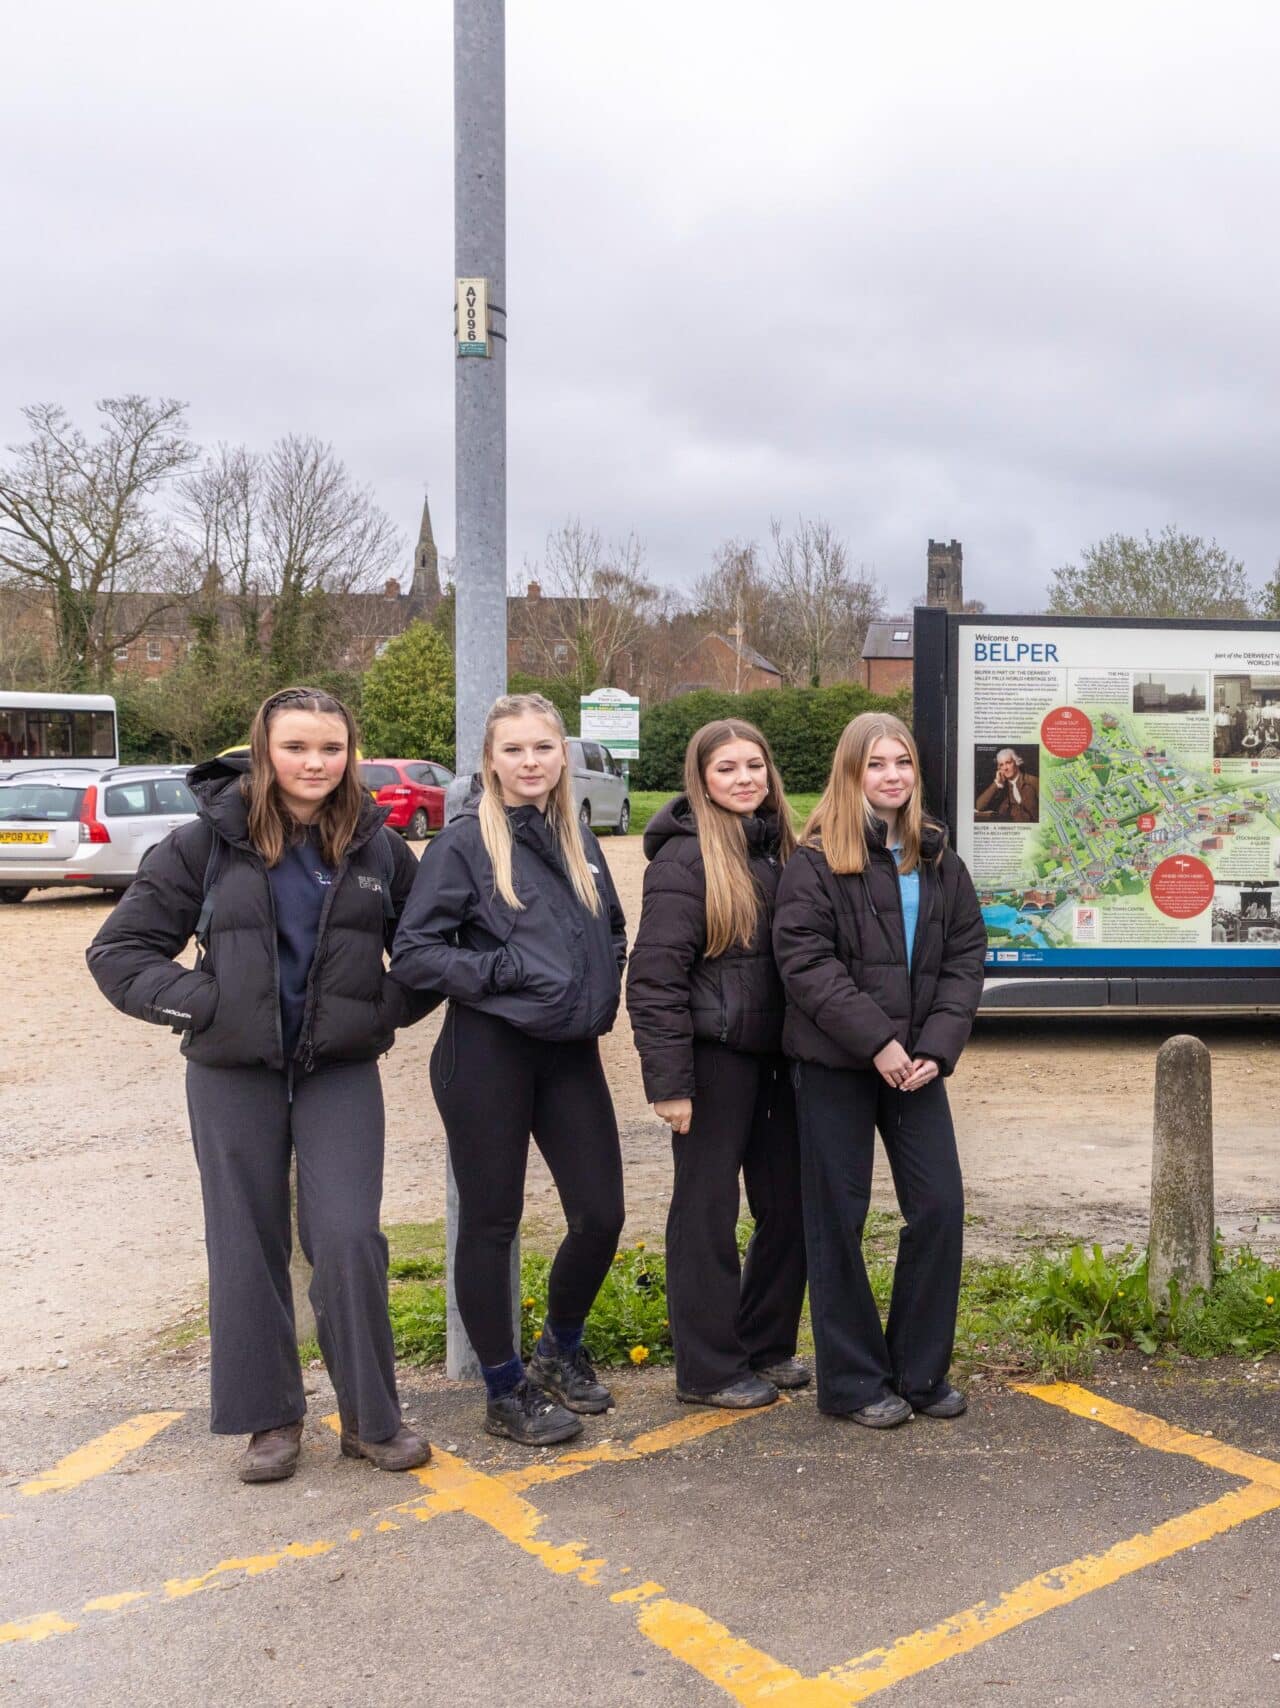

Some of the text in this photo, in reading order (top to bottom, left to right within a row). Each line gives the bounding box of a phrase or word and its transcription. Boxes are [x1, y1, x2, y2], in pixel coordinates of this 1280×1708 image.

[466, 286, 476, 341] AV096
[975, 633, 1009, 641] Welcome
[974, 642, 1060, 663] BELPER
